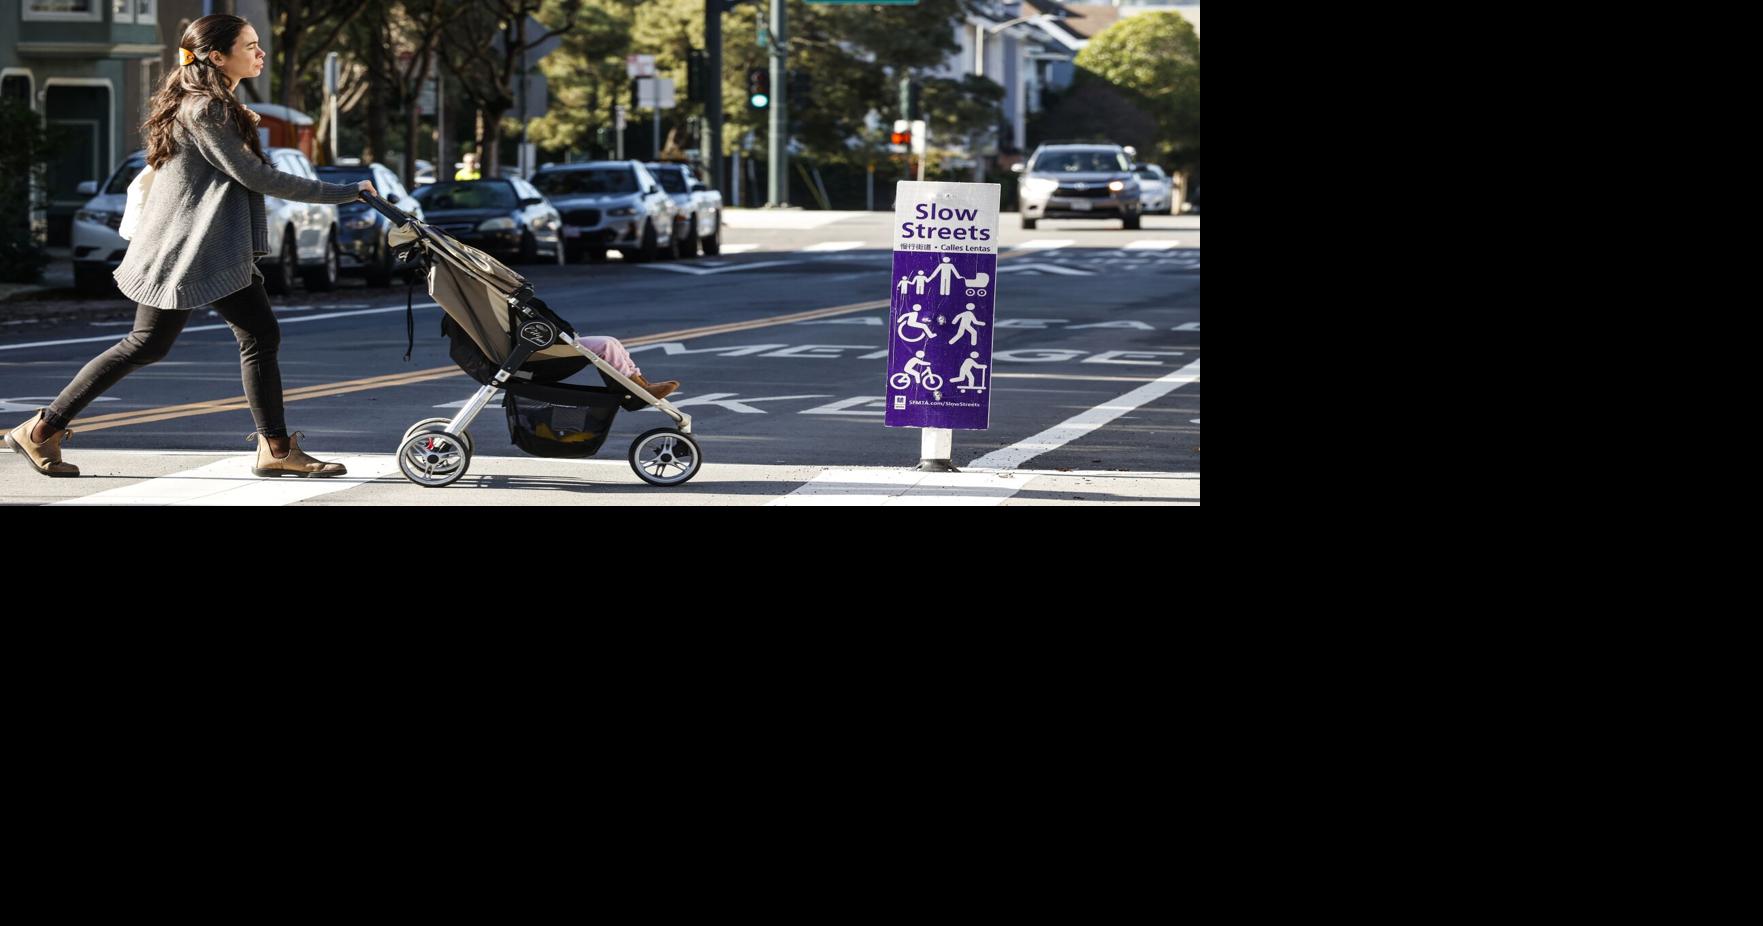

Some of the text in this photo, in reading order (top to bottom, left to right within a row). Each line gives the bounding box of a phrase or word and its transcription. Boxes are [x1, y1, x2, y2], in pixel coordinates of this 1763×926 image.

[915, 202, 978, 221] Slow
[901, 222, 991, 241] Streets
[940, 244, 991, 253] Calles Lentas
[626, 342, 1184, 366] MEGE
[908, 400, 981, 408] SFMTA.com/SlowStreets
